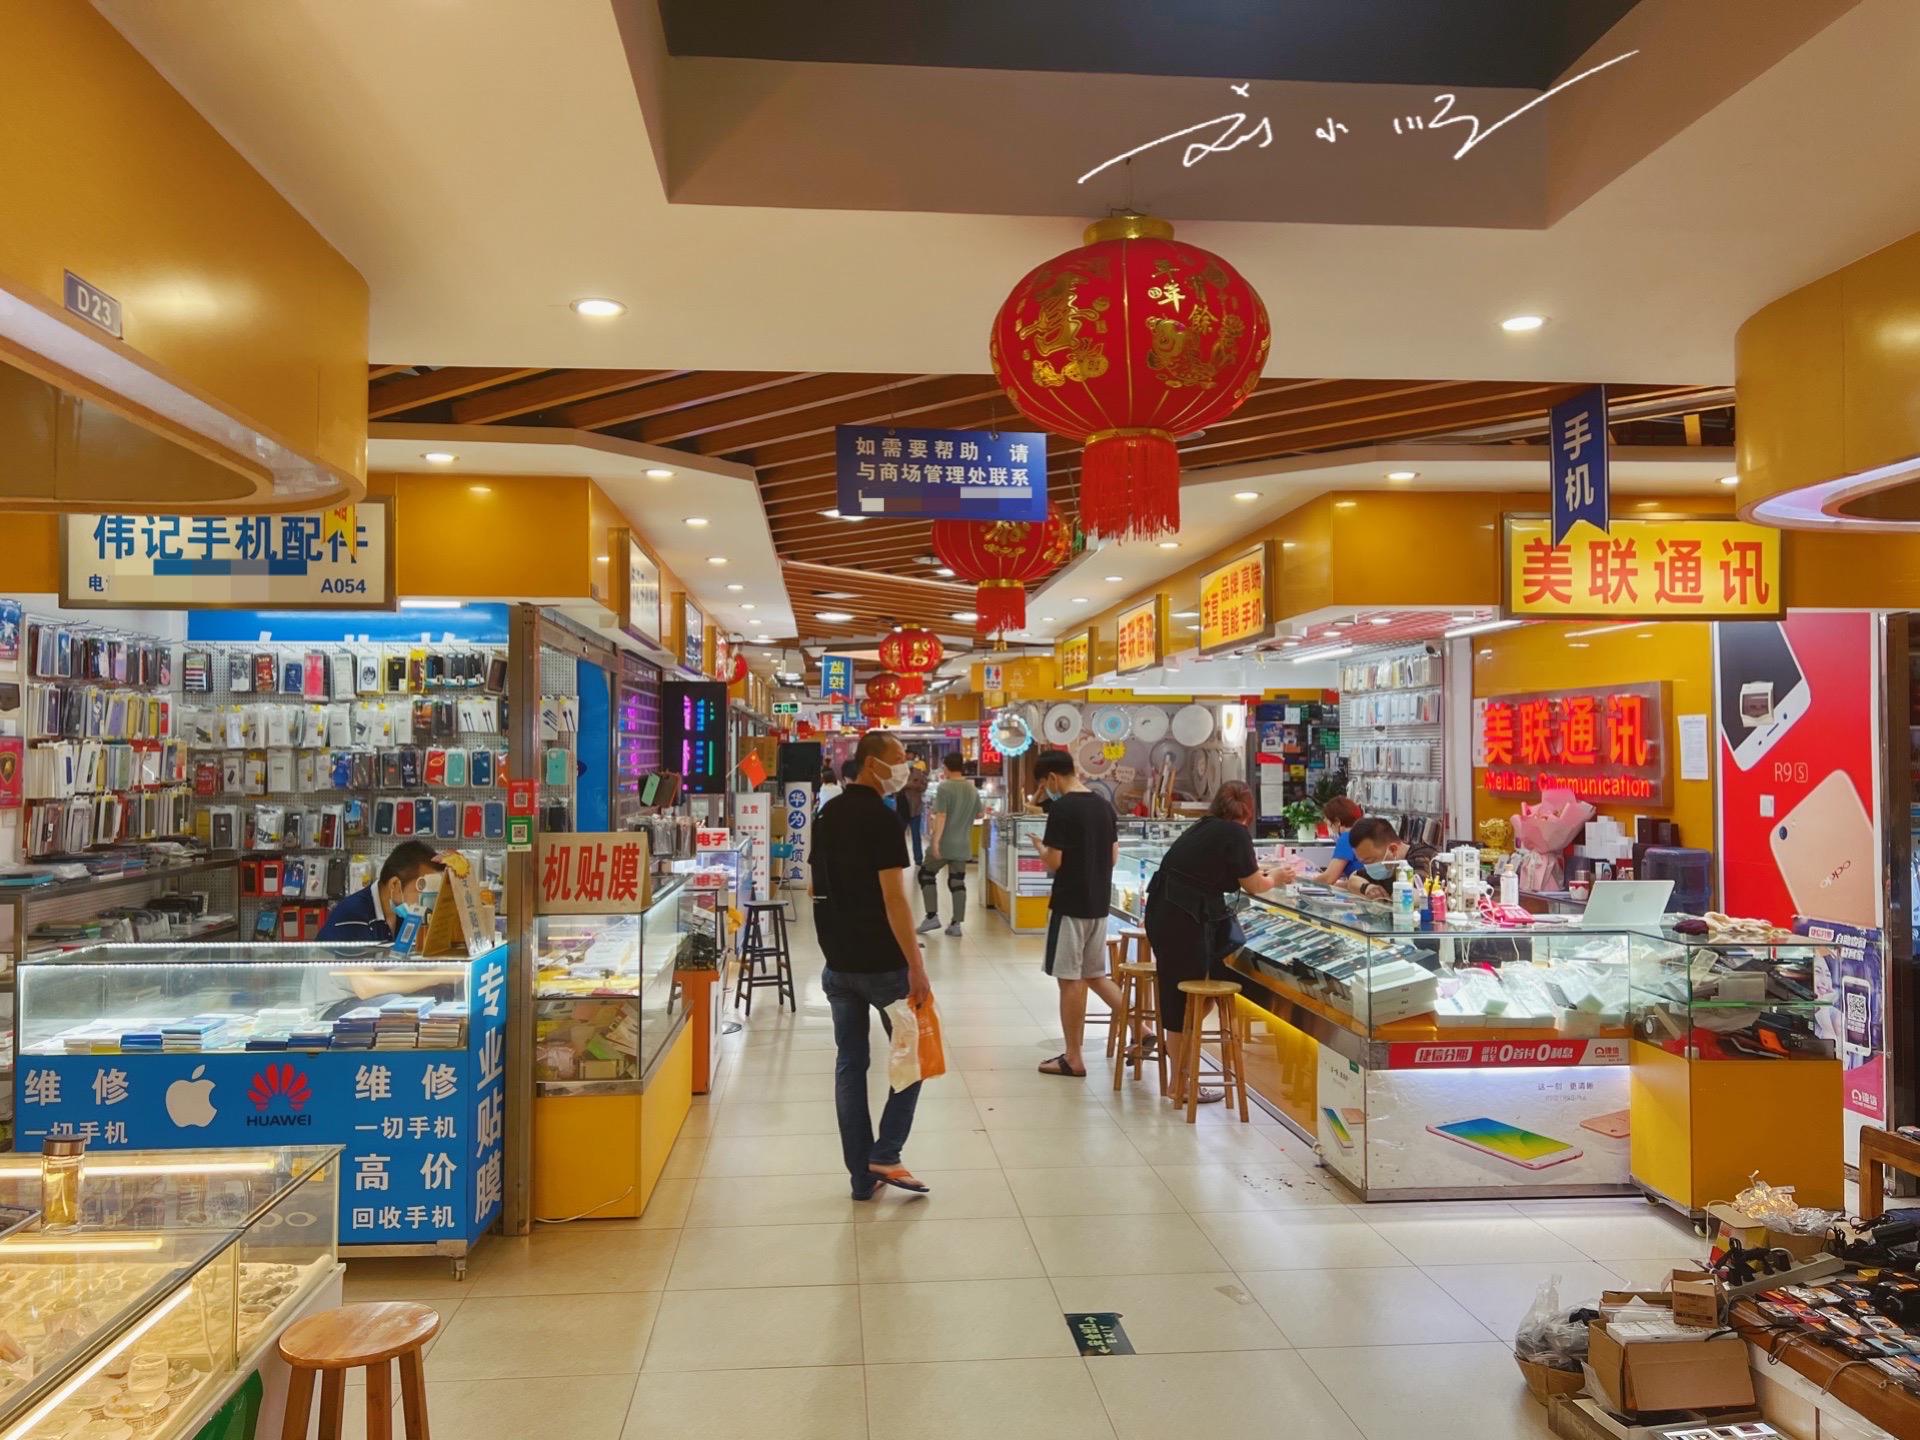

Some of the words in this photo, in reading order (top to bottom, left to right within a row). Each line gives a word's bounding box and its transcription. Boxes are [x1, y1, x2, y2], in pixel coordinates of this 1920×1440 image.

[78, 285, 112, 326] D23
[856, 463, 1029, 486] 与商场管理处联系
[1563, 410, 1595, 512] 手机
[320, 579, 367, 594] A054
[1522, 537, 1769, 605] 美联通讯
[1484, 694, 1649, 768] 美联通讯
[696, 832, 727, 847] 电子
[787, 789, 806, 881] 华为机顶盒
[543, 843, 640, 902] 机贴膜
[1418, 1047, 1470, 1061] 捷信分期
[24, 1068, 129, 1106] 维修
[355, 1064, 458, 1101] 维修
[475, 962, 504, 1225] 专业贴膜
[246, 1114, 312, 1127] HUAWEI
[354, 1116, 457, 1140] 一切手机
[354, 1152, 458, 1191] 高价
[352, 1204, 456, 1230] 回收手机
[1078, 1323, 1106, 1347] 安全出口
[1099, 1325, 1118, 1345] EXIT
